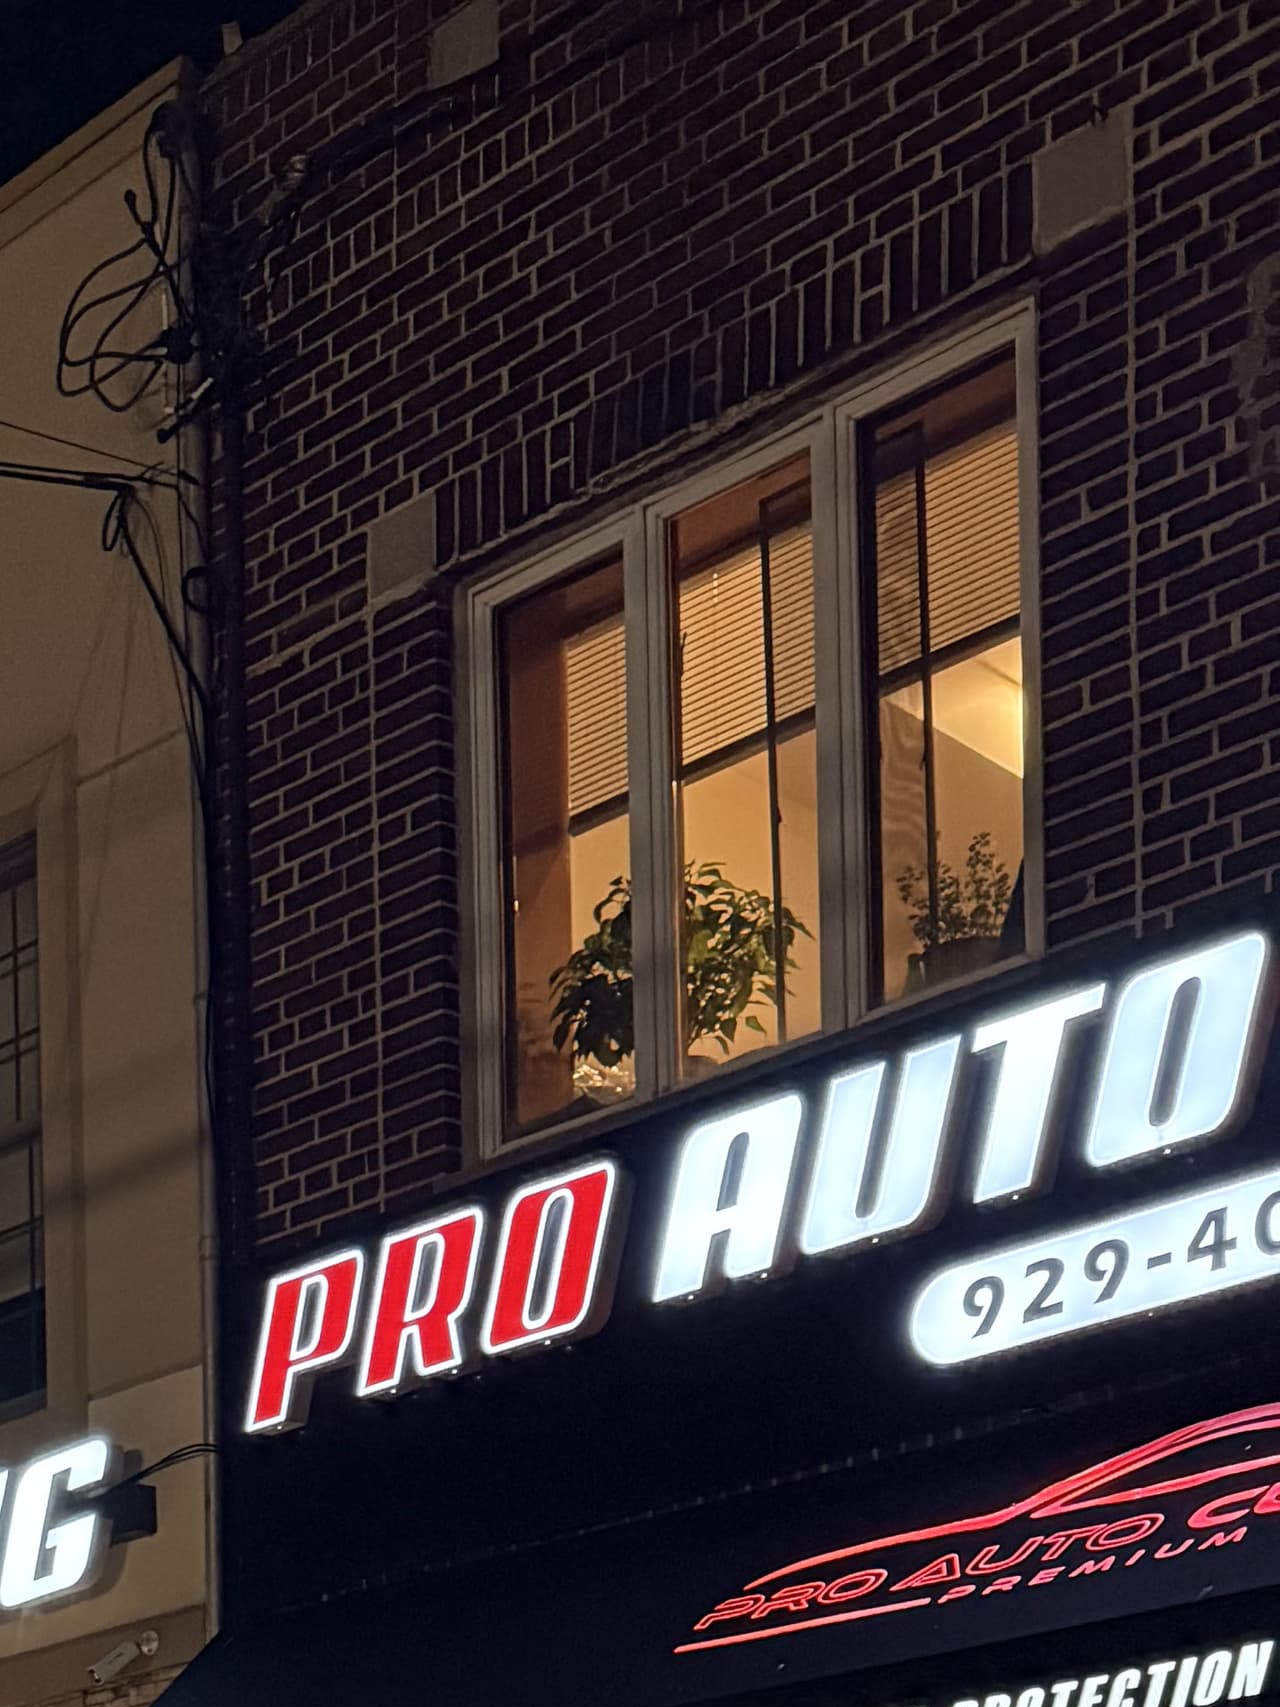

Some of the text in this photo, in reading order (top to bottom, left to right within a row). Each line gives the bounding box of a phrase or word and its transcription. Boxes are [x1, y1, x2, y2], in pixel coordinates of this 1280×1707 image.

[245, 931, 1268, 1435] PRO AUTO
[693, 1568, 889, 1631] PRO
[889, 1512, 1165, 1592] AUTO
[937, 1526, 1248, 1604] PREMIUM
